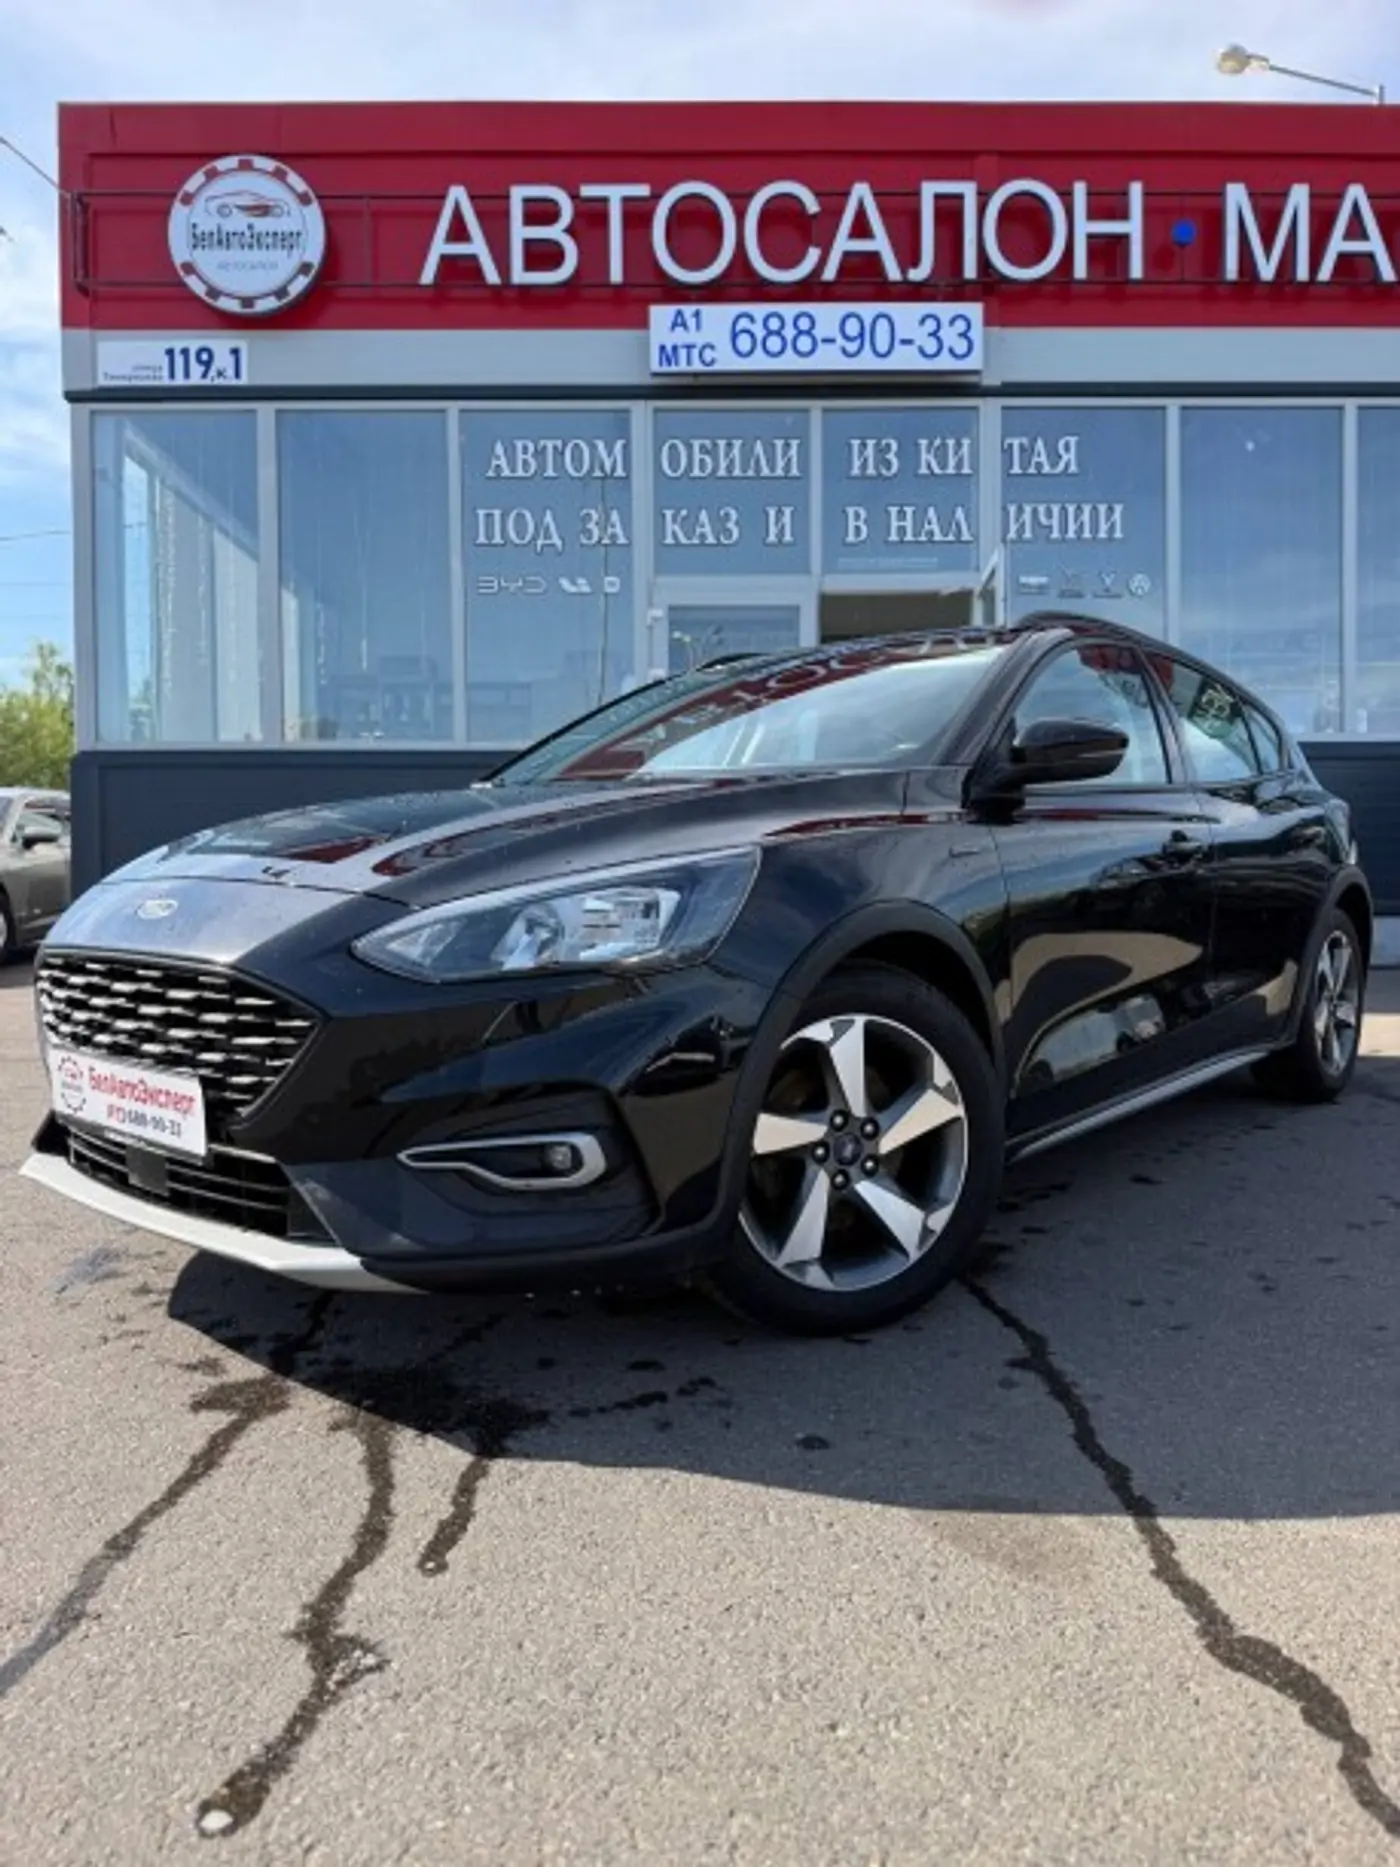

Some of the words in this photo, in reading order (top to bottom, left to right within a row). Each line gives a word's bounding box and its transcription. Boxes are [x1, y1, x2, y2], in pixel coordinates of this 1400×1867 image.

[418, 179, 1144, 284] АВТОСАЛОН
[657, 342, 717, 368] МТС
[730, 310, 975, 361] 688-90-33
[848, 438, 900, 476] ИЗ
[473, 508, 564, 554] ПОД
[764, 506, 795, 546] И
[843, 506, 869, 543] В
